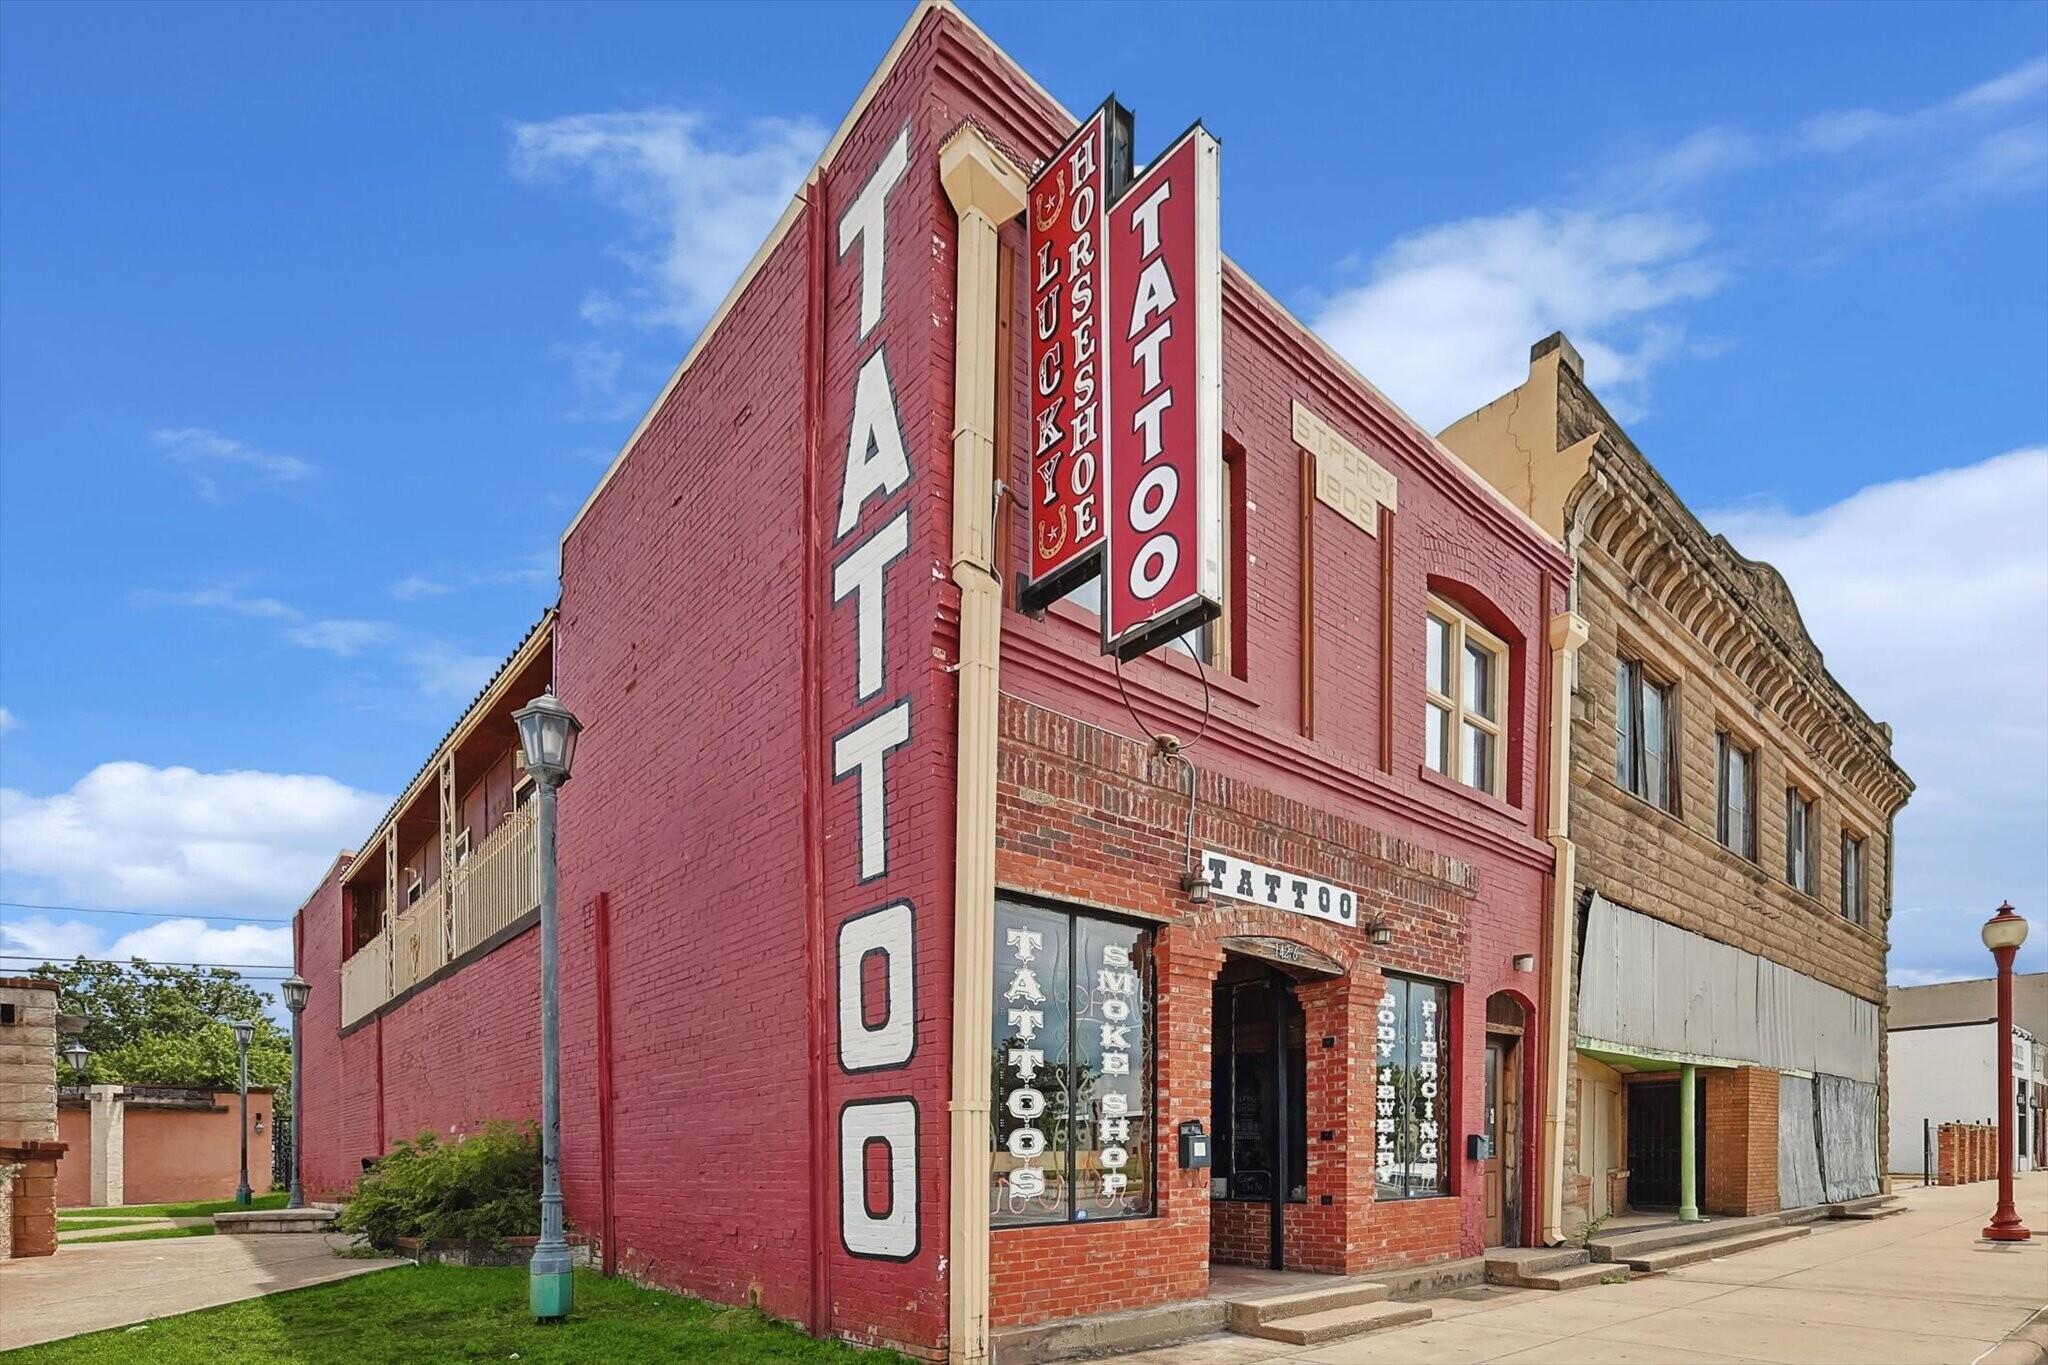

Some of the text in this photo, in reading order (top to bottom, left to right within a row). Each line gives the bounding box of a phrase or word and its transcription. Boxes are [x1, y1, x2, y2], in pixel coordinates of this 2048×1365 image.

[1036, 241, 1061, 507] LUCKY
[1069, 131, 1098, 544] HORSESHOE
[1127, 177, 1180, 601] TATTOO
[835, 122, 921, 1261] TATTOO
[1208, 857, 1352, 920] TATTOO
[1274, 943, 1299, 961] 1426
[1004, 925, 1047, 1202] TATTOOS
[1096, 943, 1135, 1197] SMOKE SHOP
[1376, 993, 1396, 1184] BODY JEWELRY
